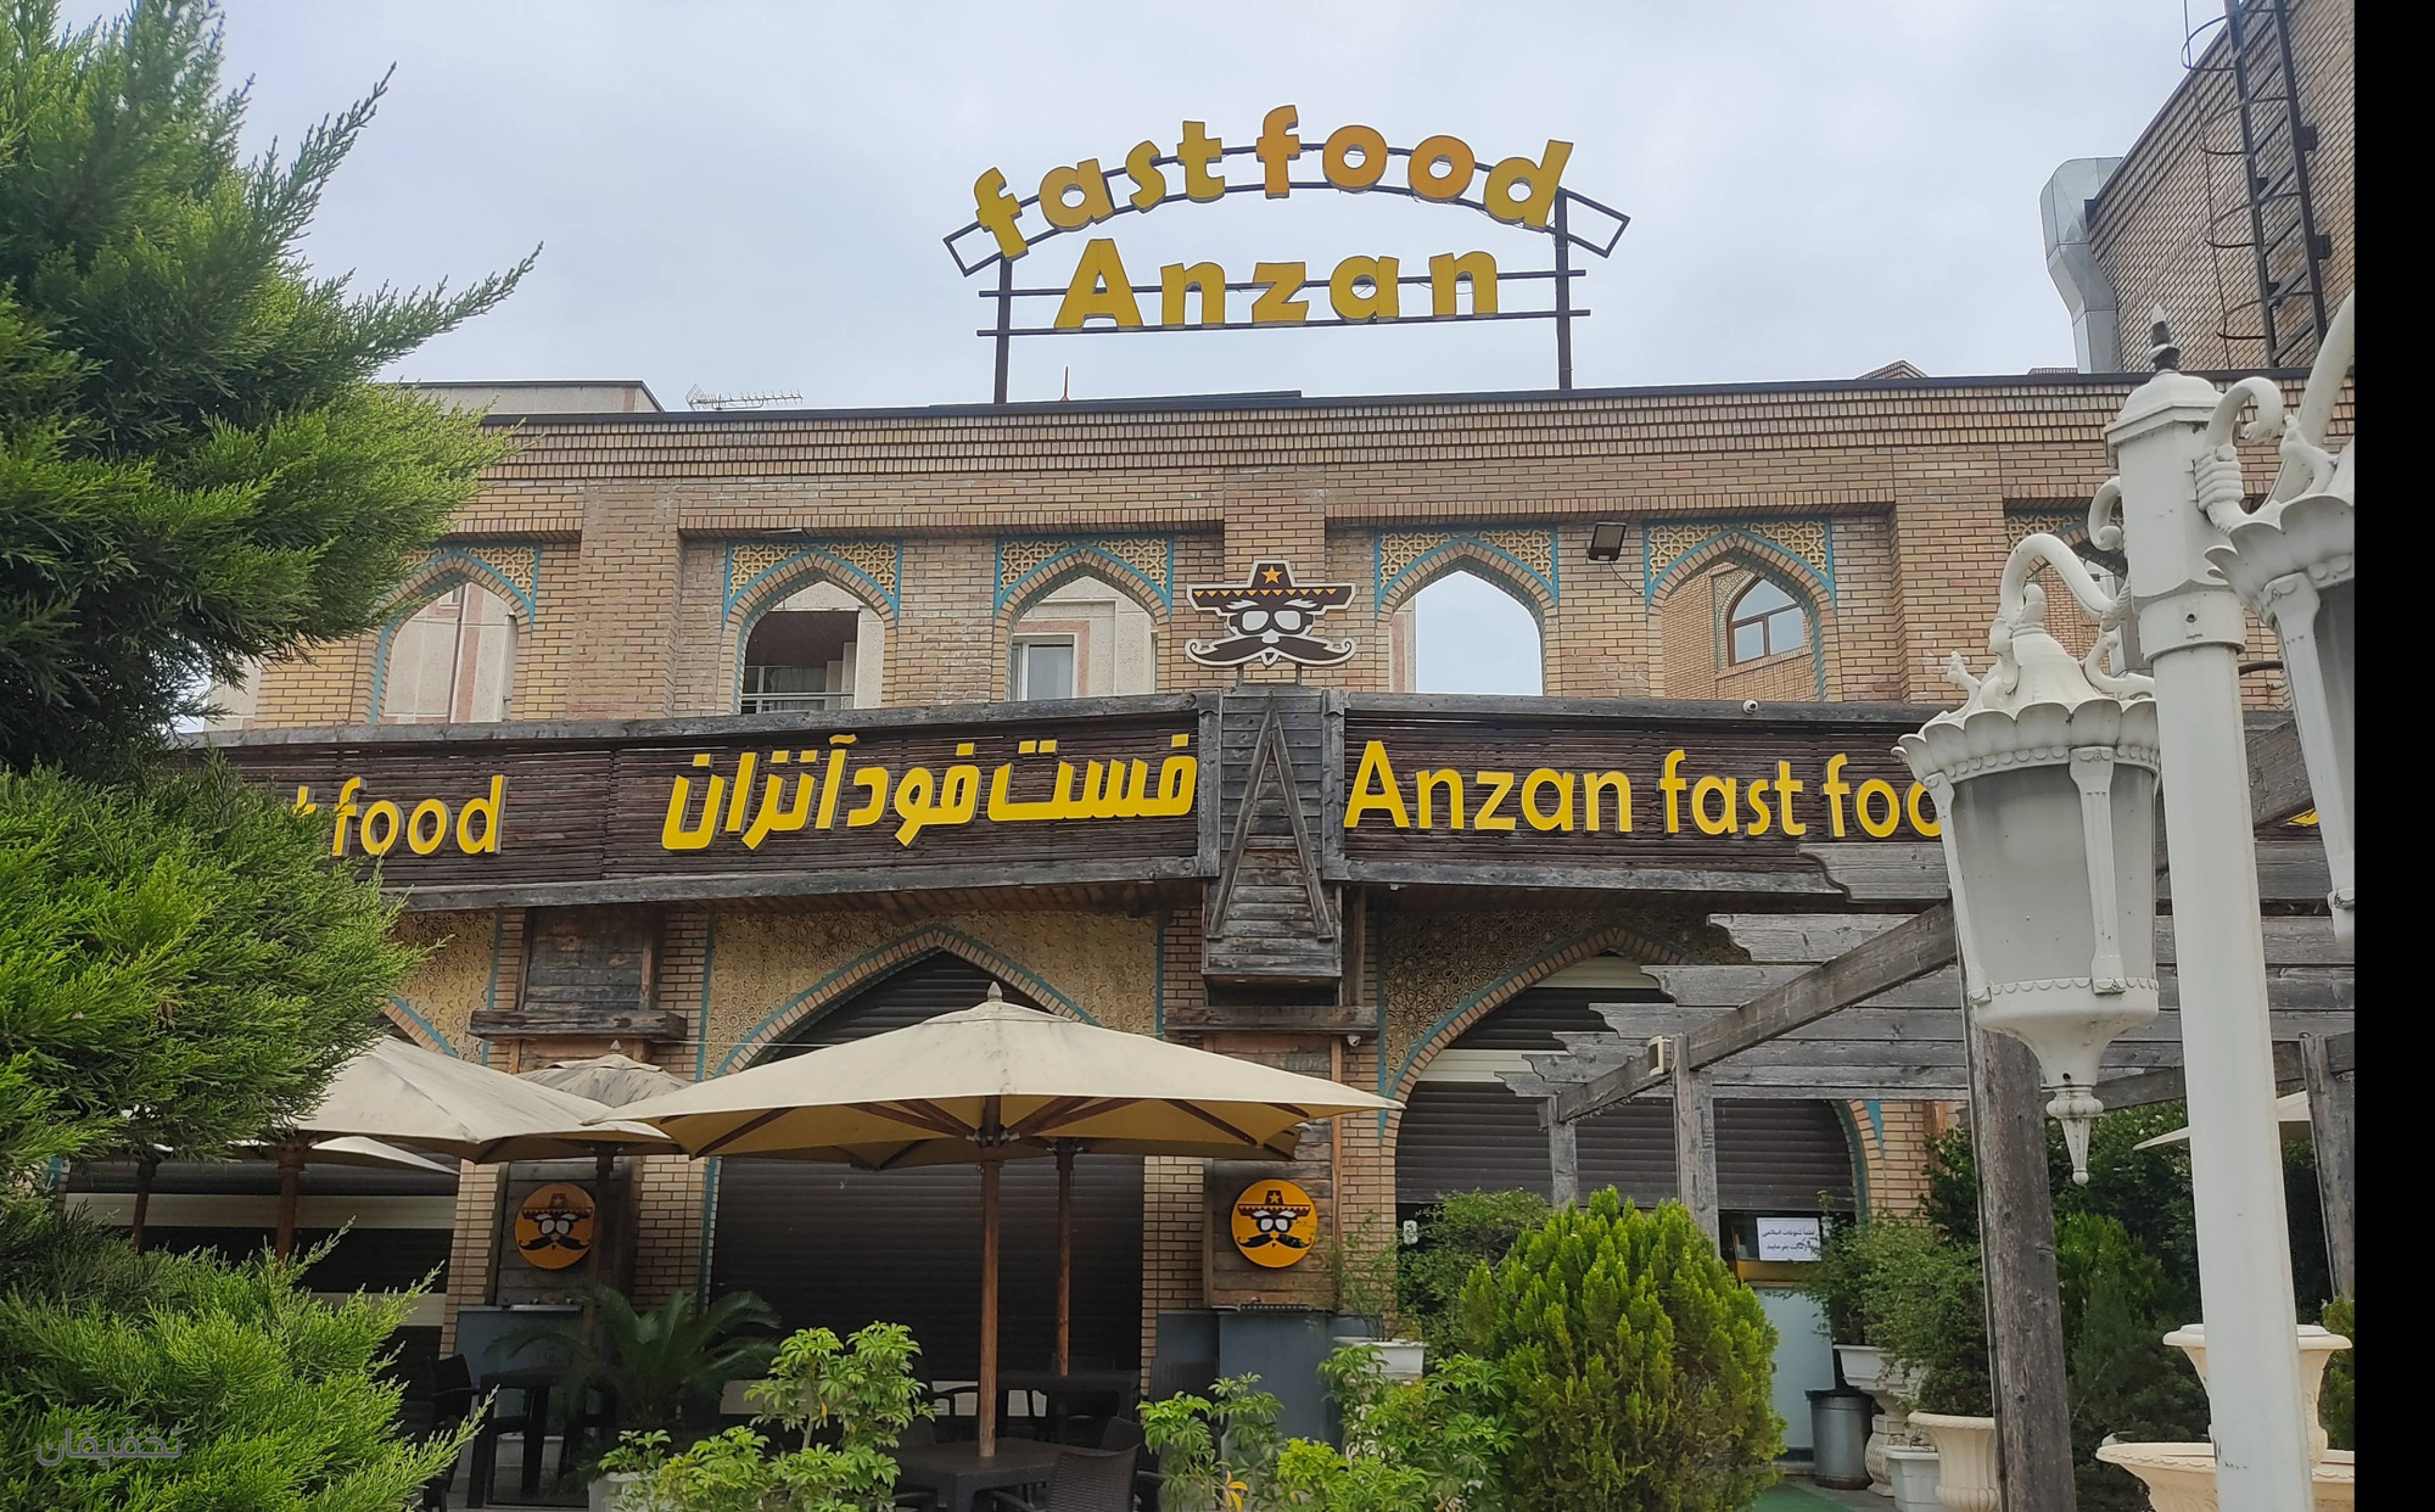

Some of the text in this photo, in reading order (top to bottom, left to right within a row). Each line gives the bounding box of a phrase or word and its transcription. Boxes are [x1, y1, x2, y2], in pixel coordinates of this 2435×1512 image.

[974, 105, 1574, 262] fast food
[1054, 238, 1497, 329] Anzan
[332, 775, 506, 856] food
[847, 743, 981, 846] فود
[987, 733, 1198, 822] فست
[1342, 740, 1942, 838] Anzan fast foo
